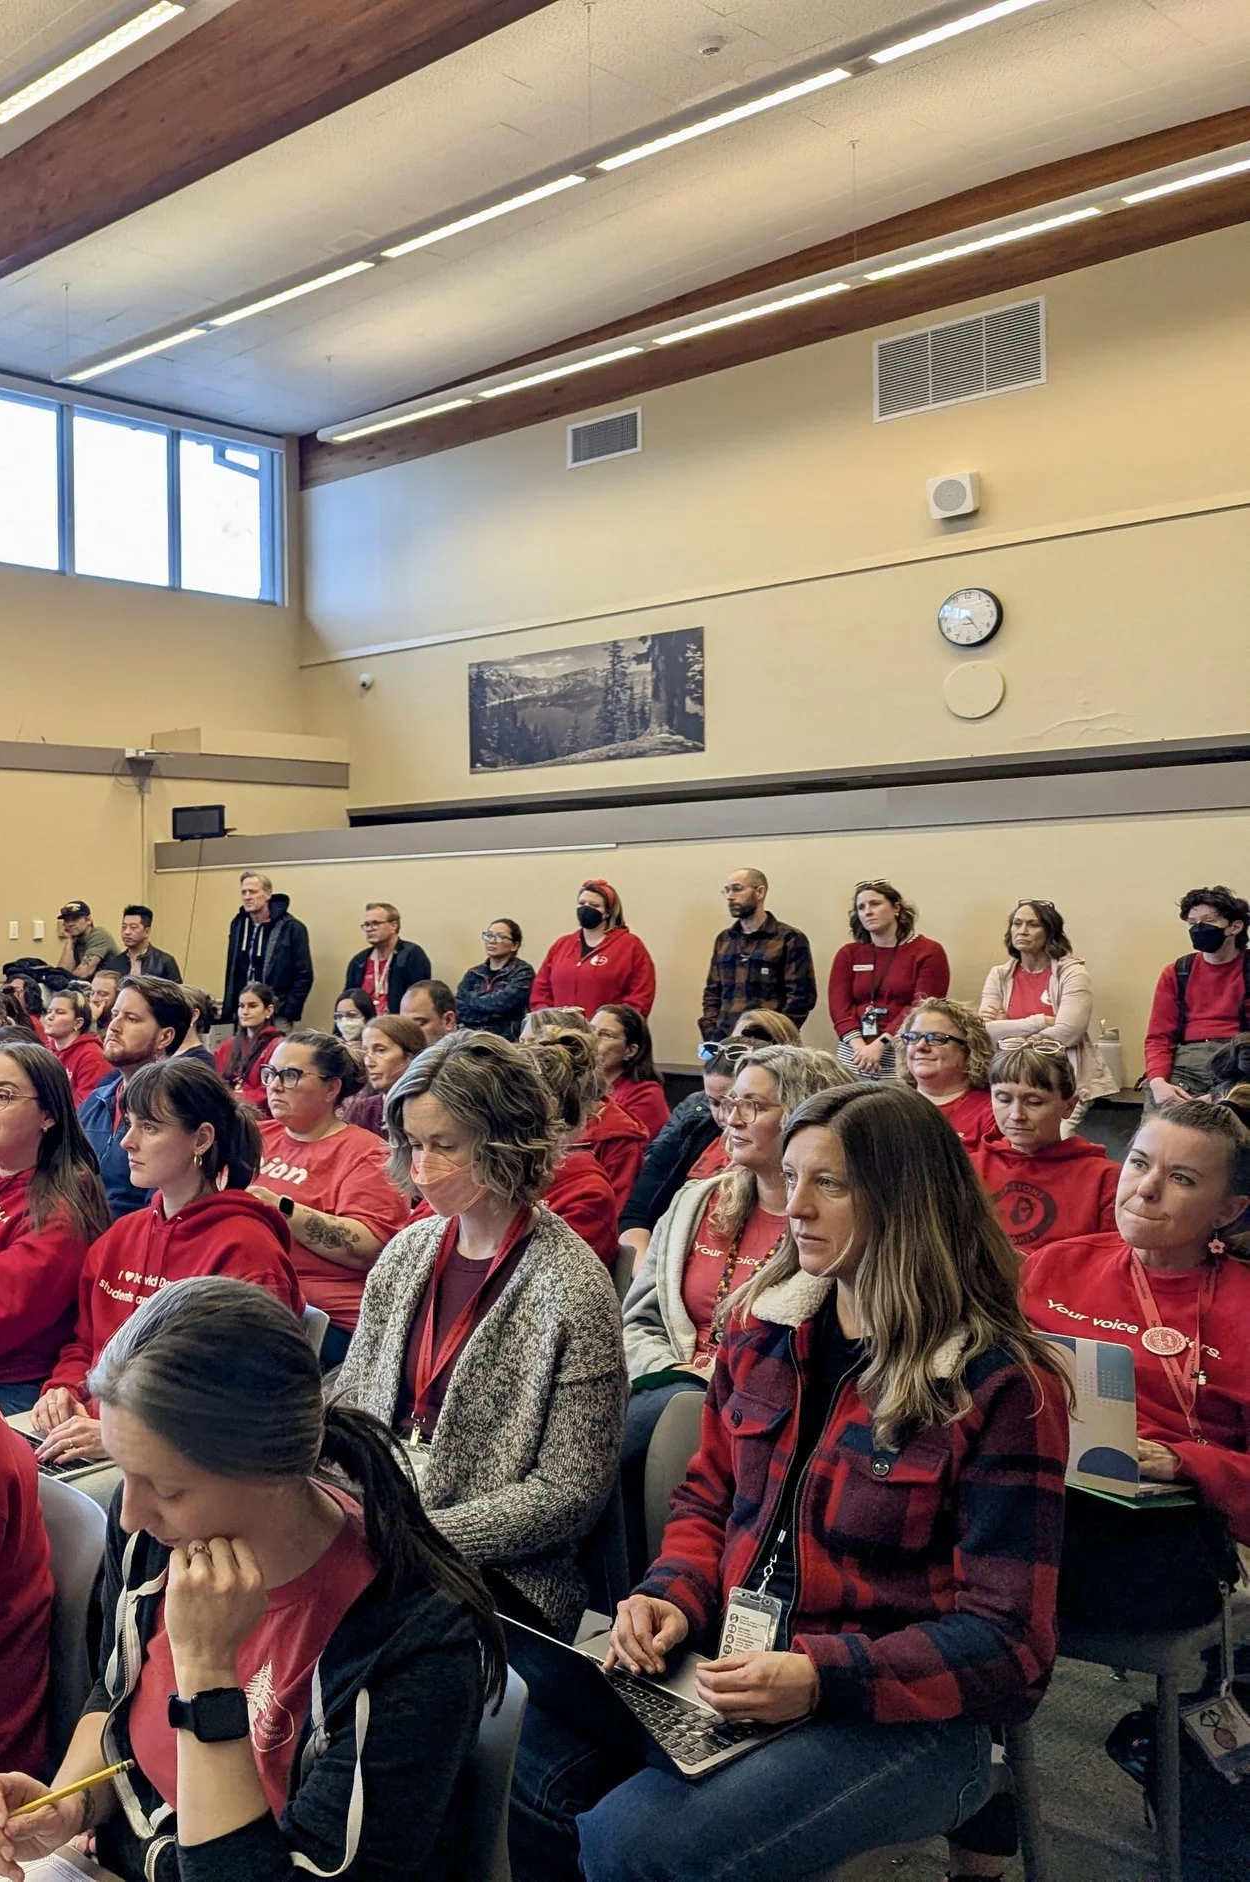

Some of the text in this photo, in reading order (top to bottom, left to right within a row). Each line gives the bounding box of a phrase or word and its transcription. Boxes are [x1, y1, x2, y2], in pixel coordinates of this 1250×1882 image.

[694, 1241, 724, 1258] Your
[118, 1270, 124, 1281] I
[98, 1279, 134, 1303] students
[1048, 1299, 1089, 1322] Your
[1093, 1313, 1139, 1335] voice
